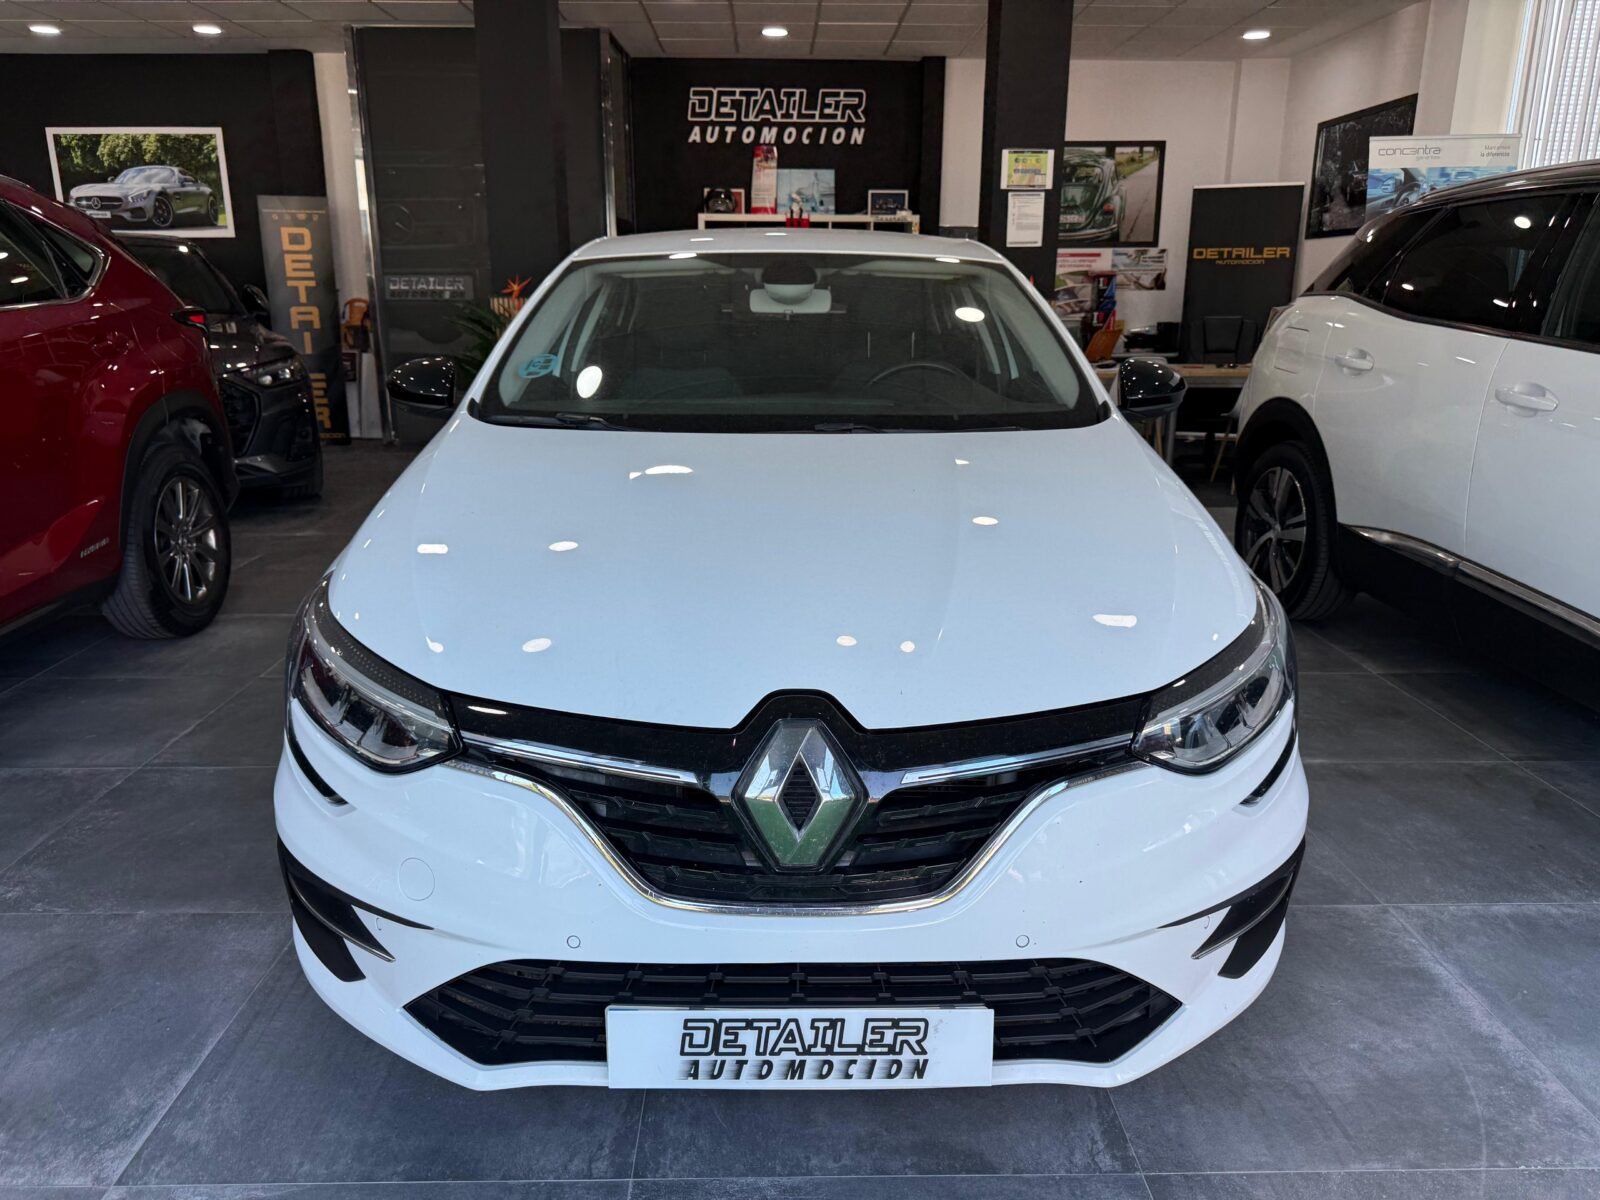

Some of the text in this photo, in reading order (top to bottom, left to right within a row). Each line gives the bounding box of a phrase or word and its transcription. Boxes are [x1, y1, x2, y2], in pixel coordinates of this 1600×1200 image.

[688, 87, 866, 123] DETAILER
[688, 126, 865, 145] AUTOMOCION
[1193, 247, 1290, 259] DETAILER
[389, 277, 465, 290] DETAILER
[280, 226, 332, 429] DETAIER
[679, 1018, 929, 1056] DETAILER
[681, 1059, 929, 1080] AUTOMOCION
